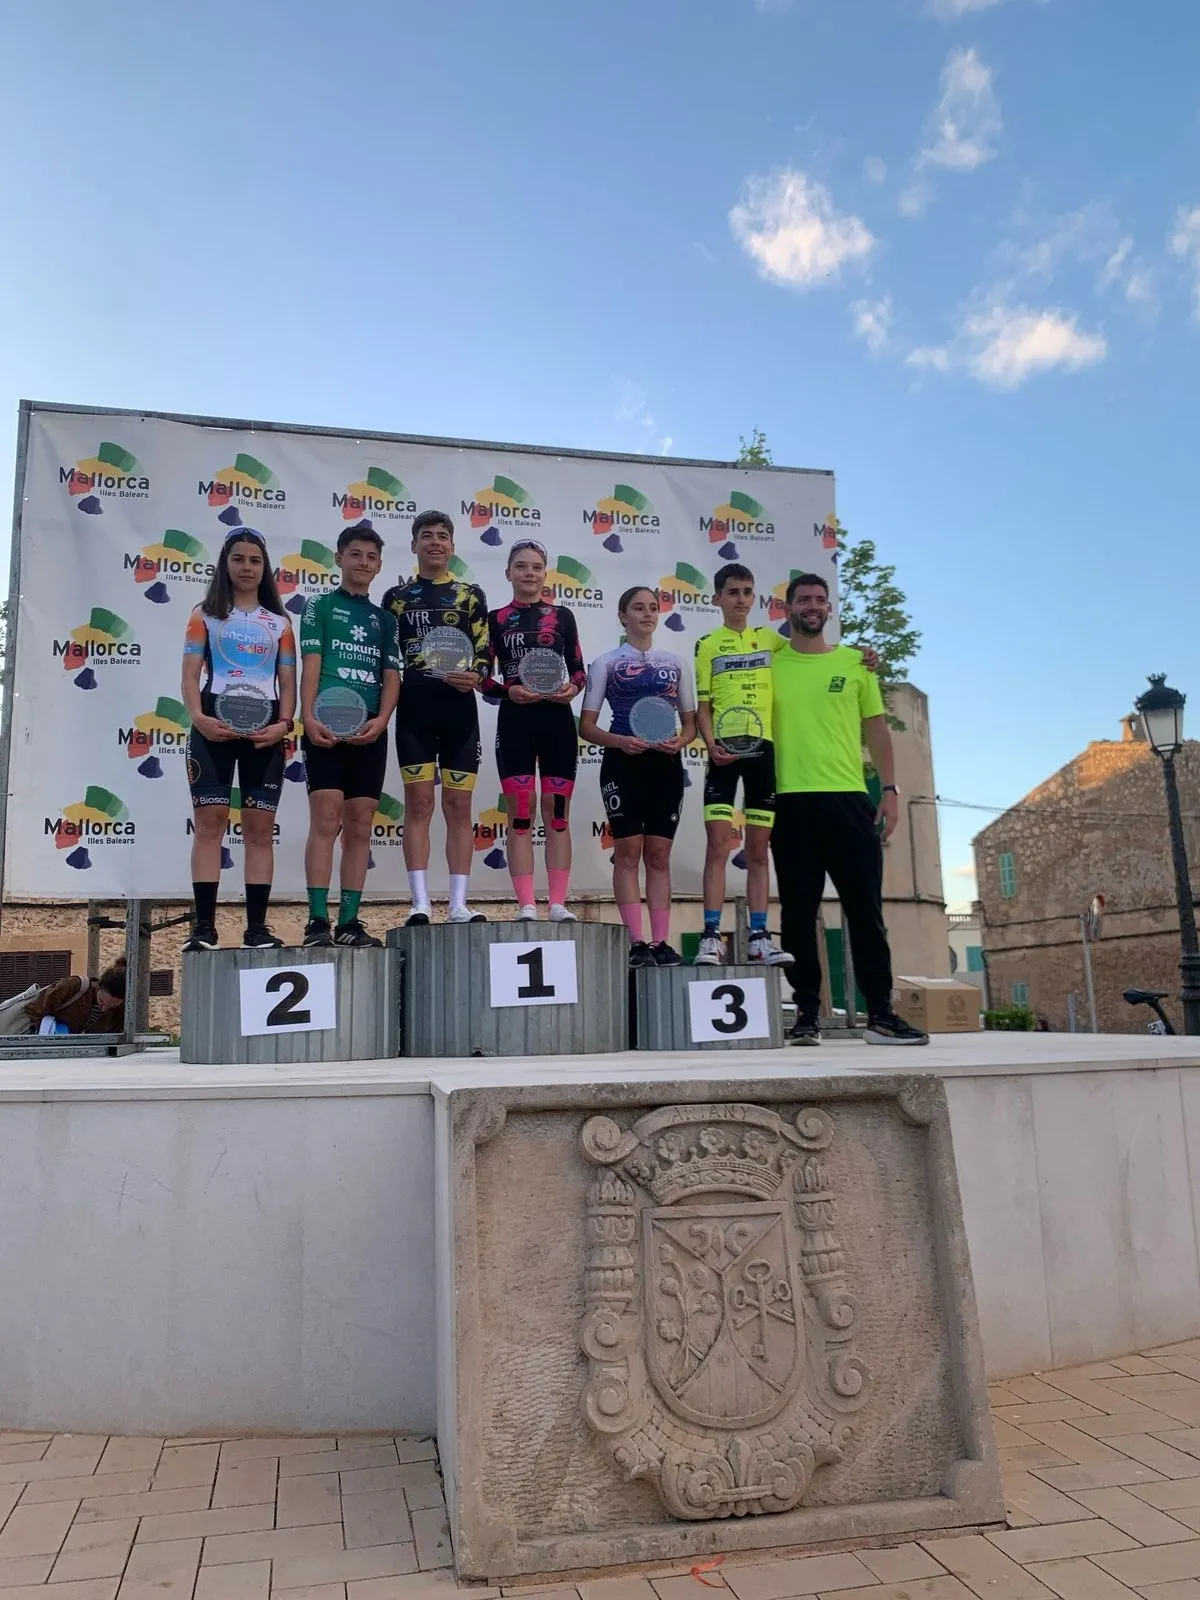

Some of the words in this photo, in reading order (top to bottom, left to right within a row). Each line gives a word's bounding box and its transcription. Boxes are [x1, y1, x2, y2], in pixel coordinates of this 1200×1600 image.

[59, 466, 150, 490] Mallorca
[99, 489, 117, 497] Illes
[119, 490, 149, 499] Balears
[198, 480, 286, 502] Mallorca
[238, 498, 255, 507] Illes
[256, 500, 285, 510] Balears
[332, 492, 417, 513] Mallorca
[461, 500, 541, 520] Mallorca
[514, 519, 541, 528] Balears
[582, 509, 660, 527] Mallorca
[699, 516, 775, 534] Mallorca
[618, 526, 634, 534] Illes
[635, 527, 660, 535] Balears
[123, 553, 216, 577] Mallorca
[165, 574, 182, 582] Illes
[304, 586, 321, 594] Illes
[541, 583, 604, 601] allorca
[577, 600, 604, 609] Balears
[52, 640, 142, 656] Mallorca
[331, 638, 381, 658] Prokuria
[110, 657, 141, 665] Balears
[338, 651, 377, 667] Holding
[337, 667, 377, 684] VIVA
[118, 727, 190, 746] Mallor
[158, 746, 176, 754] Illes
[44, 817, 136, 836] Mallorca
[87, 837, 104, 845] Illes
[106, 837, 135, 845] Balears
[516, 947, 556, 998] 1
[265, 971, 311, 1027] 2
[711, 984, 748, 1034] 3
[672, 1104, 751, 1122] ARIANY
